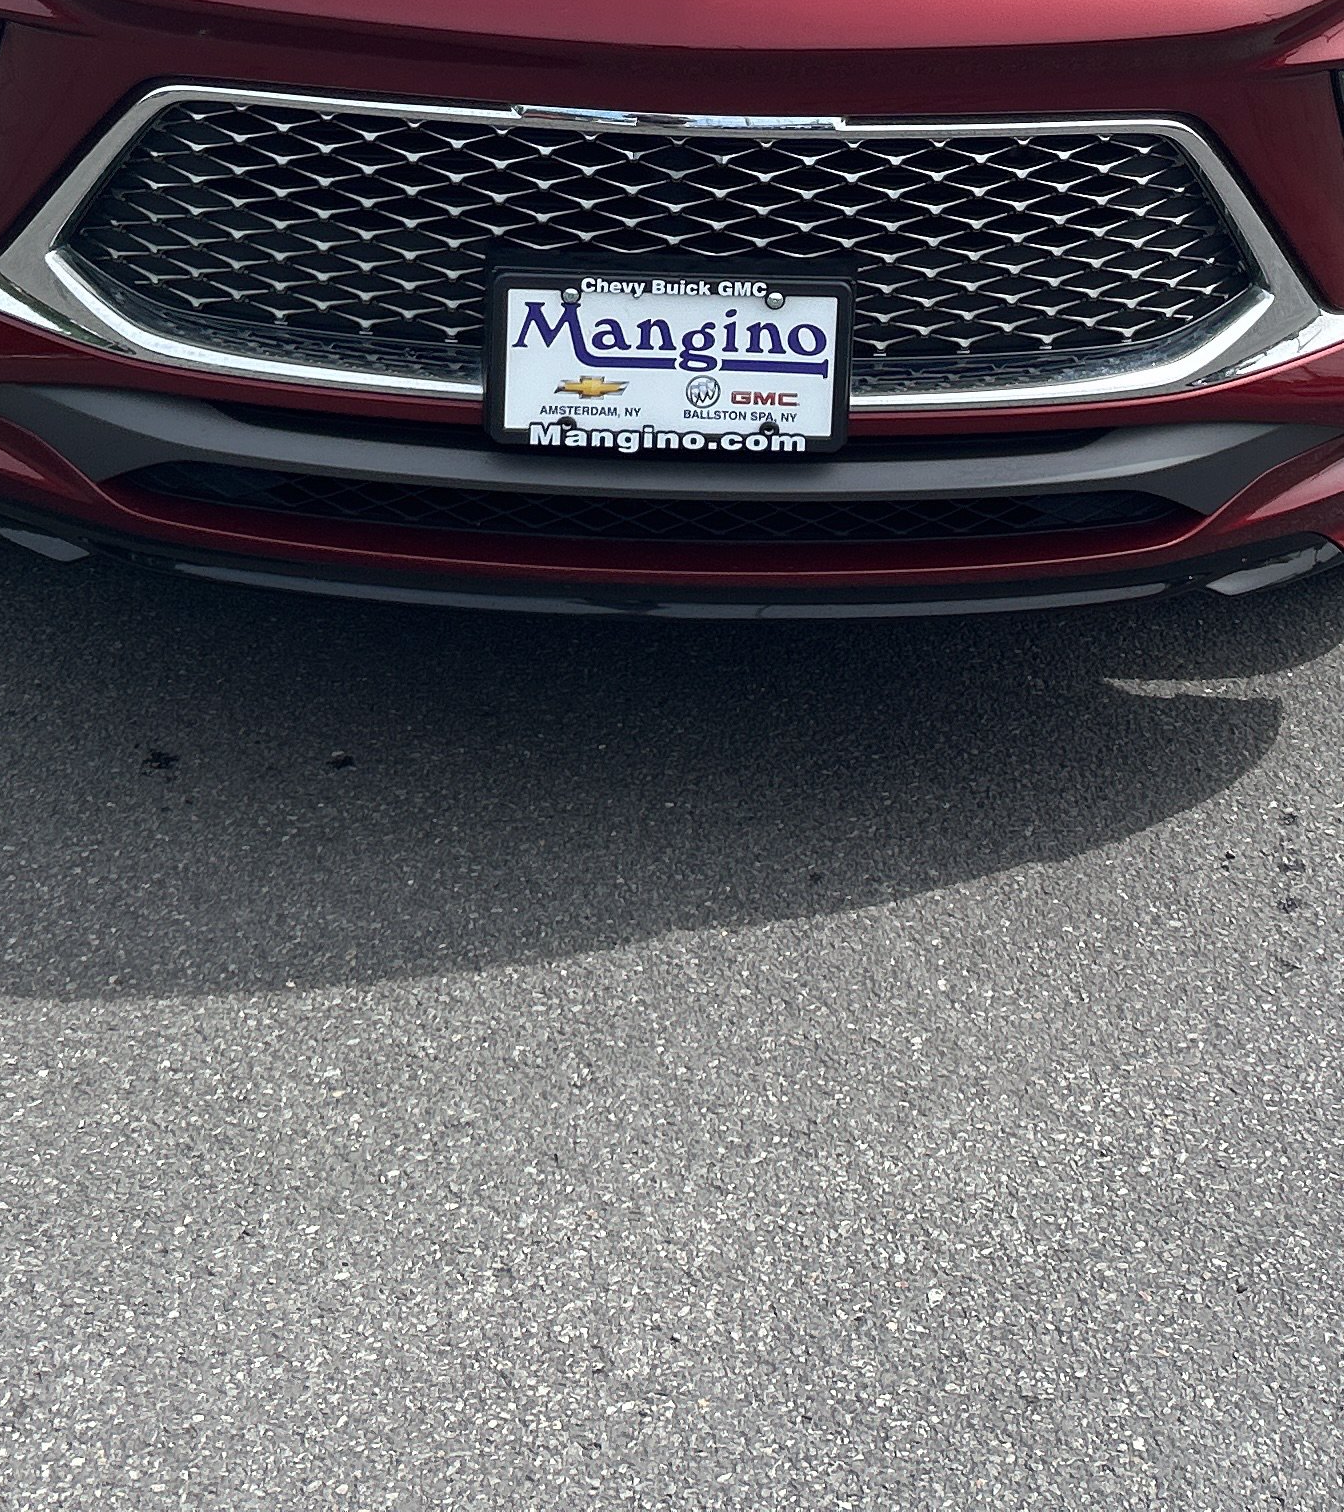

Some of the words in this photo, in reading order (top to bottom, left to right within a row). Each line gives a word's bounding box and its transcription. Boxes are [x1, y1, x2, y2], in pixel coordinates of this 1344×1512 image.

[581, 278, 645, 298] Chevy
[652, 280, 711, 296] Buick
[718, 281, 767, 297] GMC
[512, 301, 829, 375] Mangino
[730, 390, 800, 407] GMC
[539, 405, 620, 419] AMSTERDAM,
[624, 407, 641, 418] NY
[683, 409, 747, 421] BALLSTON
[750, 411, 777, 424] SPA,
[780, 412, 797, 423] NY
[529, 422, 806, 453] Mangino.com
